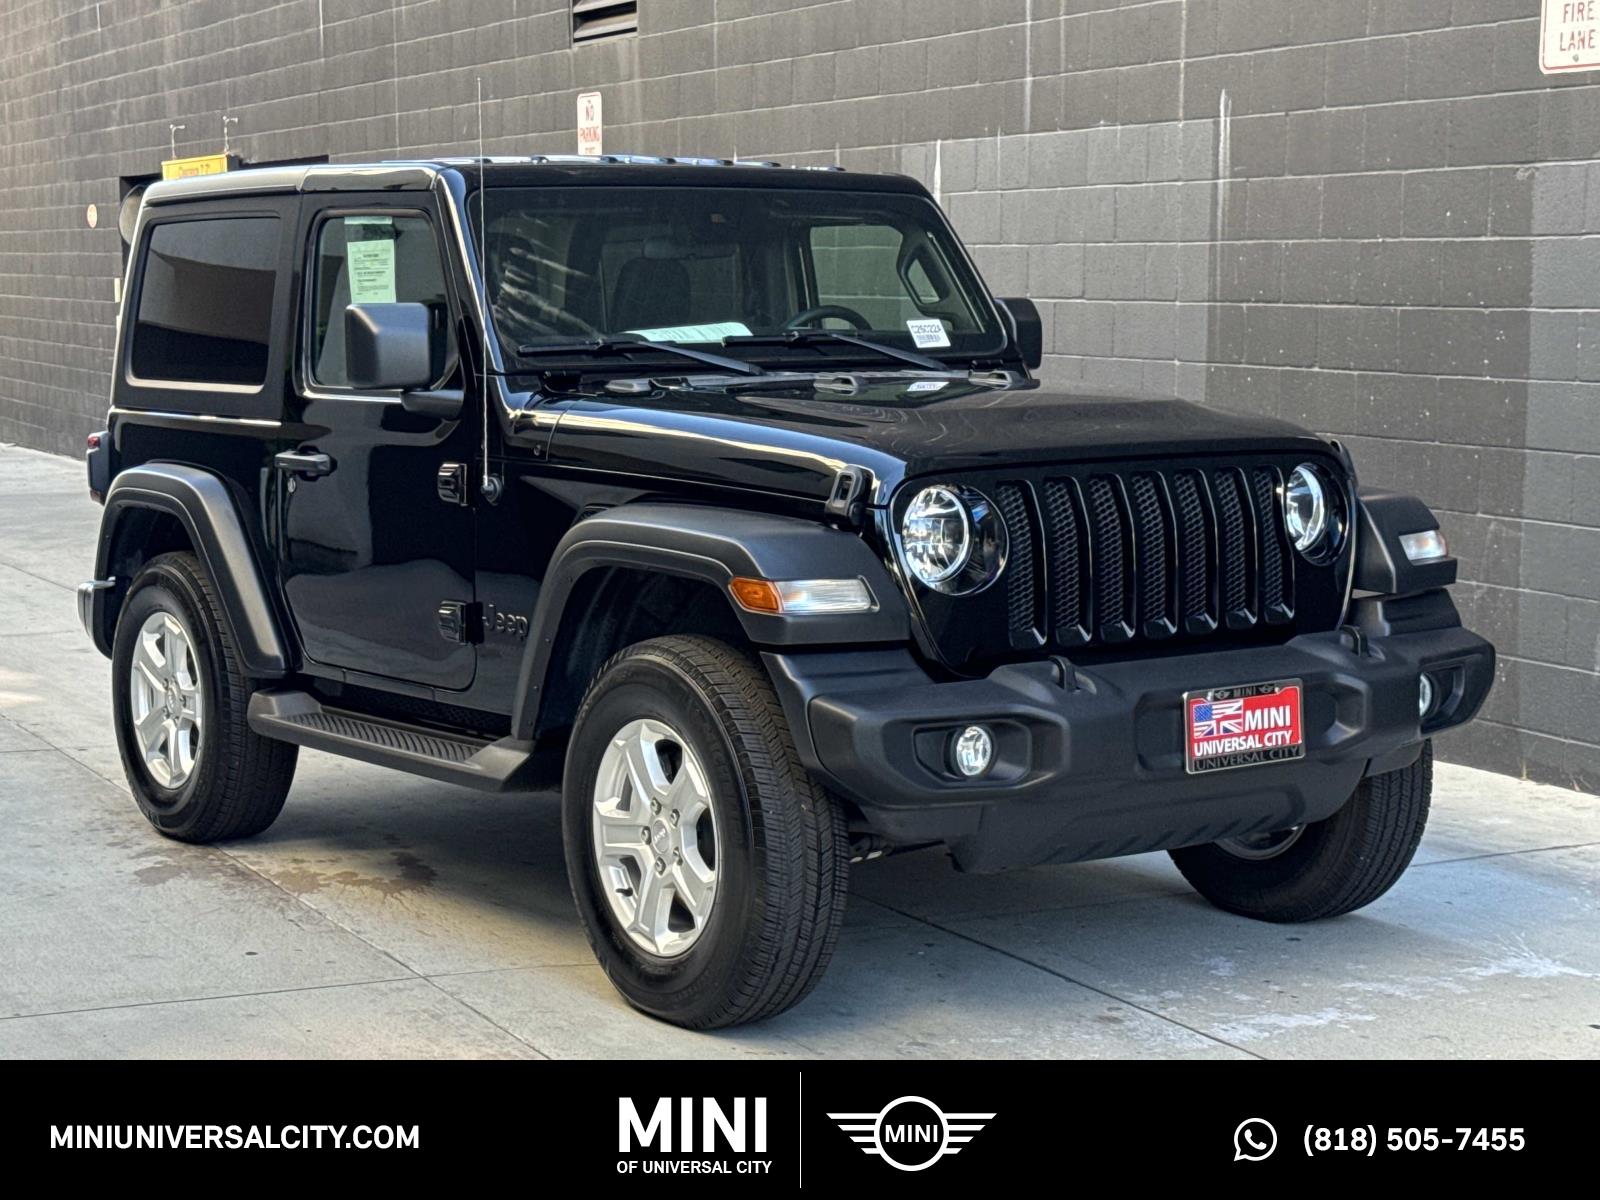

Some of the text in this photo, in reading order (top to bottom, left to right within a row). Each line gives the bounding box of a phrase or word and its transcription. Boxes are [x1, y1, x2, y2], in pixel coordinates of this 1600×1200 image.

[1562, 0, 1595, 23] FIRE
[1559, 29, 1596, 51] LANE
[585, 104, 594, 121] NO
[481, 603, 528, 640] Jeep
[1233, 686, 1257, 698] MINI
[1244, 705, 1291, 732] MINI
[1194, 730, 1293, 757] UNIVERSAL CITY
[1196, 746, 1299, 770] UNIVERSAL CITY
